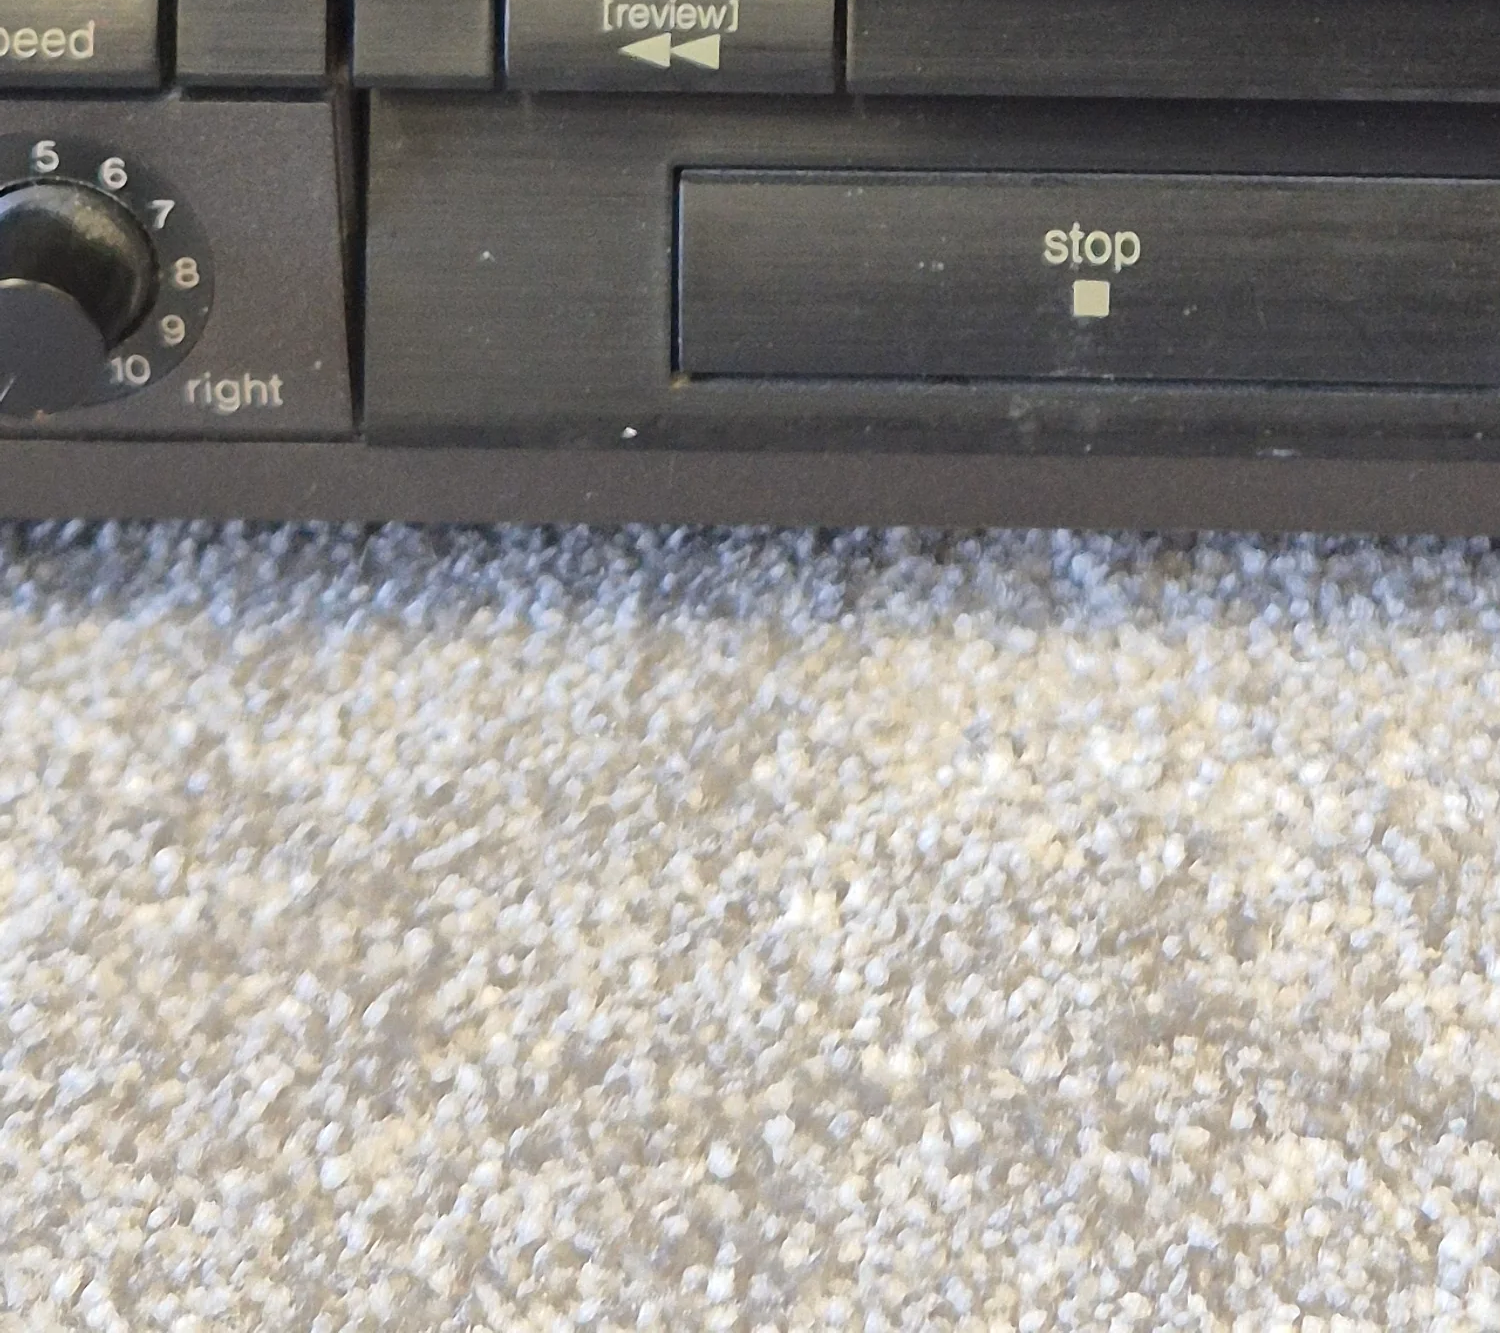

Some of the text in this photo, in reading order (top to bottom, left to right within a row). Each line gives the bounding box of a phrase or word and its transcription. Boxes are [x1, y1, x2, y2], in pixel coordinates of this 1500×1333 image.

[32, 139, 60, 172] 5
[99, 156, 128, 191] 6
[150, 199, 175, 230] 7
[1043, 221, 1142, 273] stop
[173, 256, 200, 289] 8
[160, 313, 186, 346] 9
[109, 352, 152, 386] 10
[186, 371, 285, 413] right
